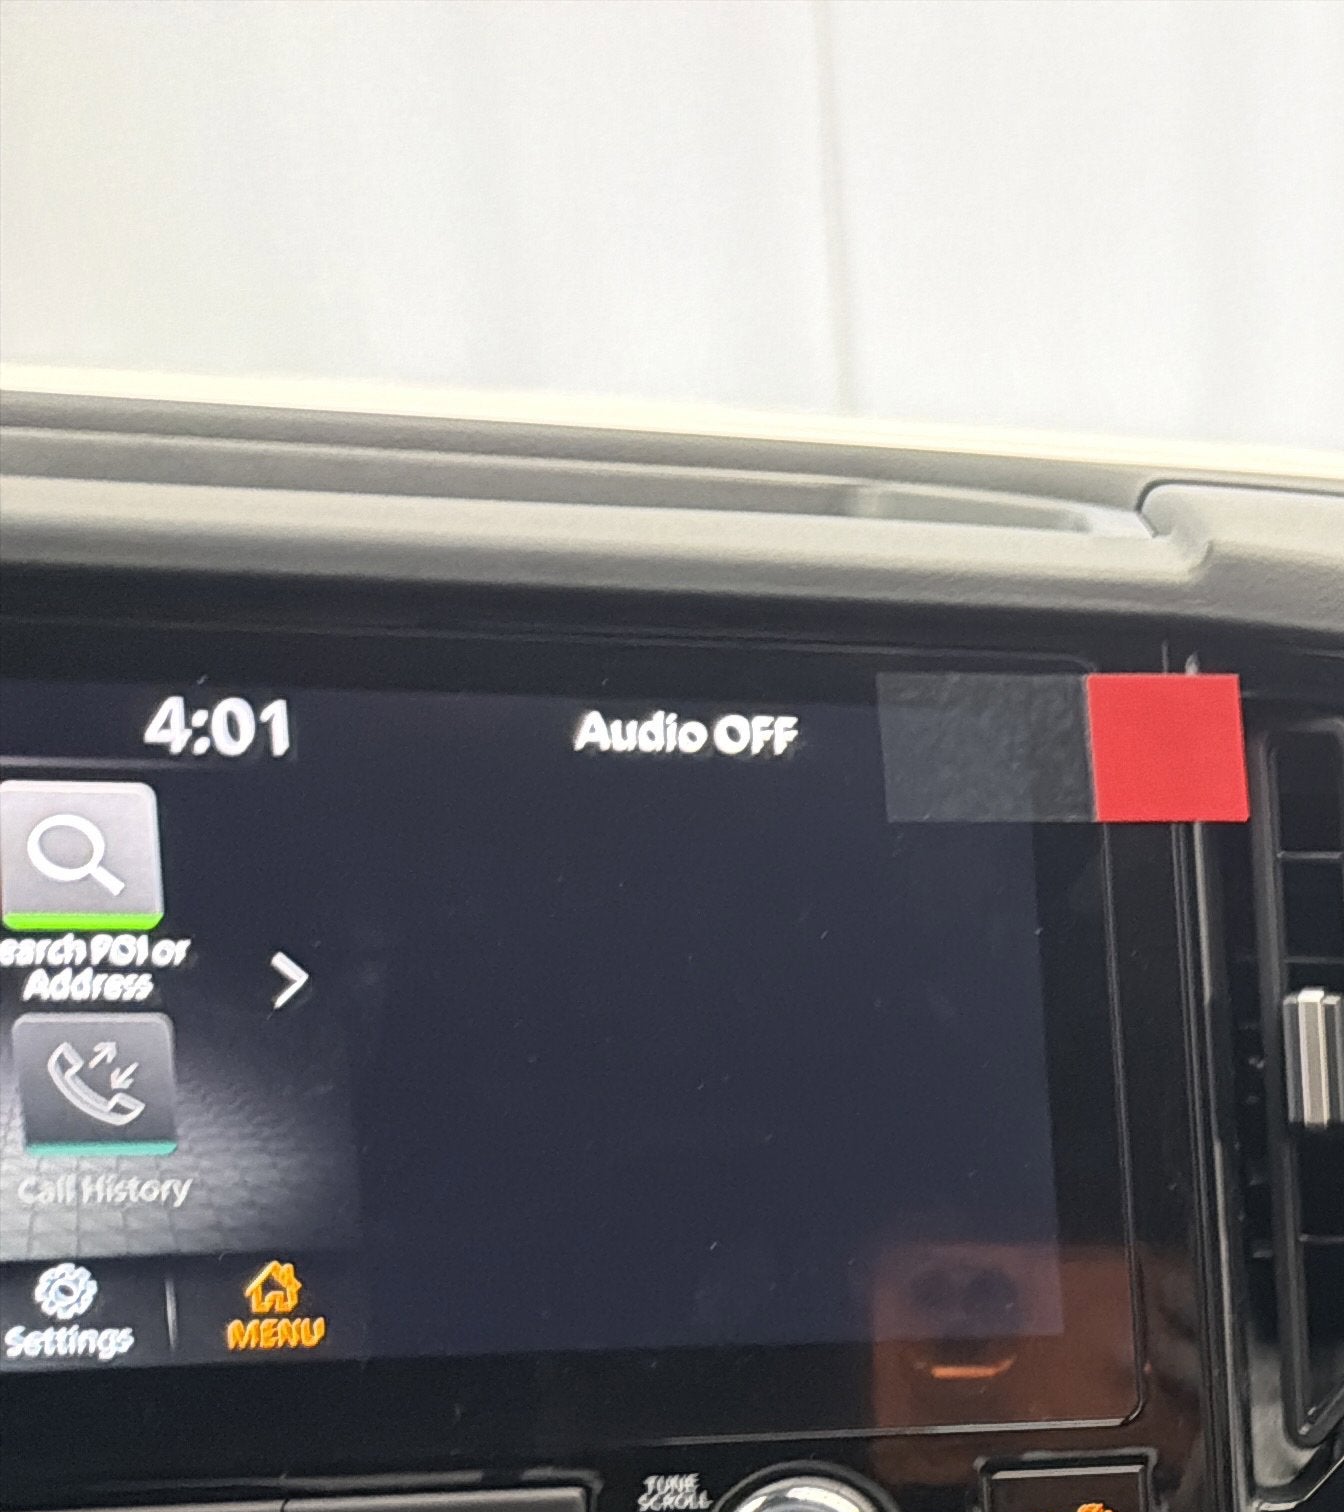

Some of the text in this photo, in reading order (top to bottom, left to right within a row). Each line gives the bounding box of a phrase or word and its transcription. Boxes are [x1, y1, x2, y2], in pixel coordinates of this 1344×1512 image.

[143, 695, 290, 757] 4:01
[573, 710, 798, 755] Audio OFF
[90, 934, 148, 966] POI
[151, 939, 191, 967] or
[22, 967, 154, 1001] Address
[17, 1174, 193, 1208] Call History
[4, 1325, 134, 1360] Settings
[227, 1316, 325, 1350] MENU
[643, 1473, 699, 1494] TUNE
[637, 1490, 714, 1512] SCROLL
